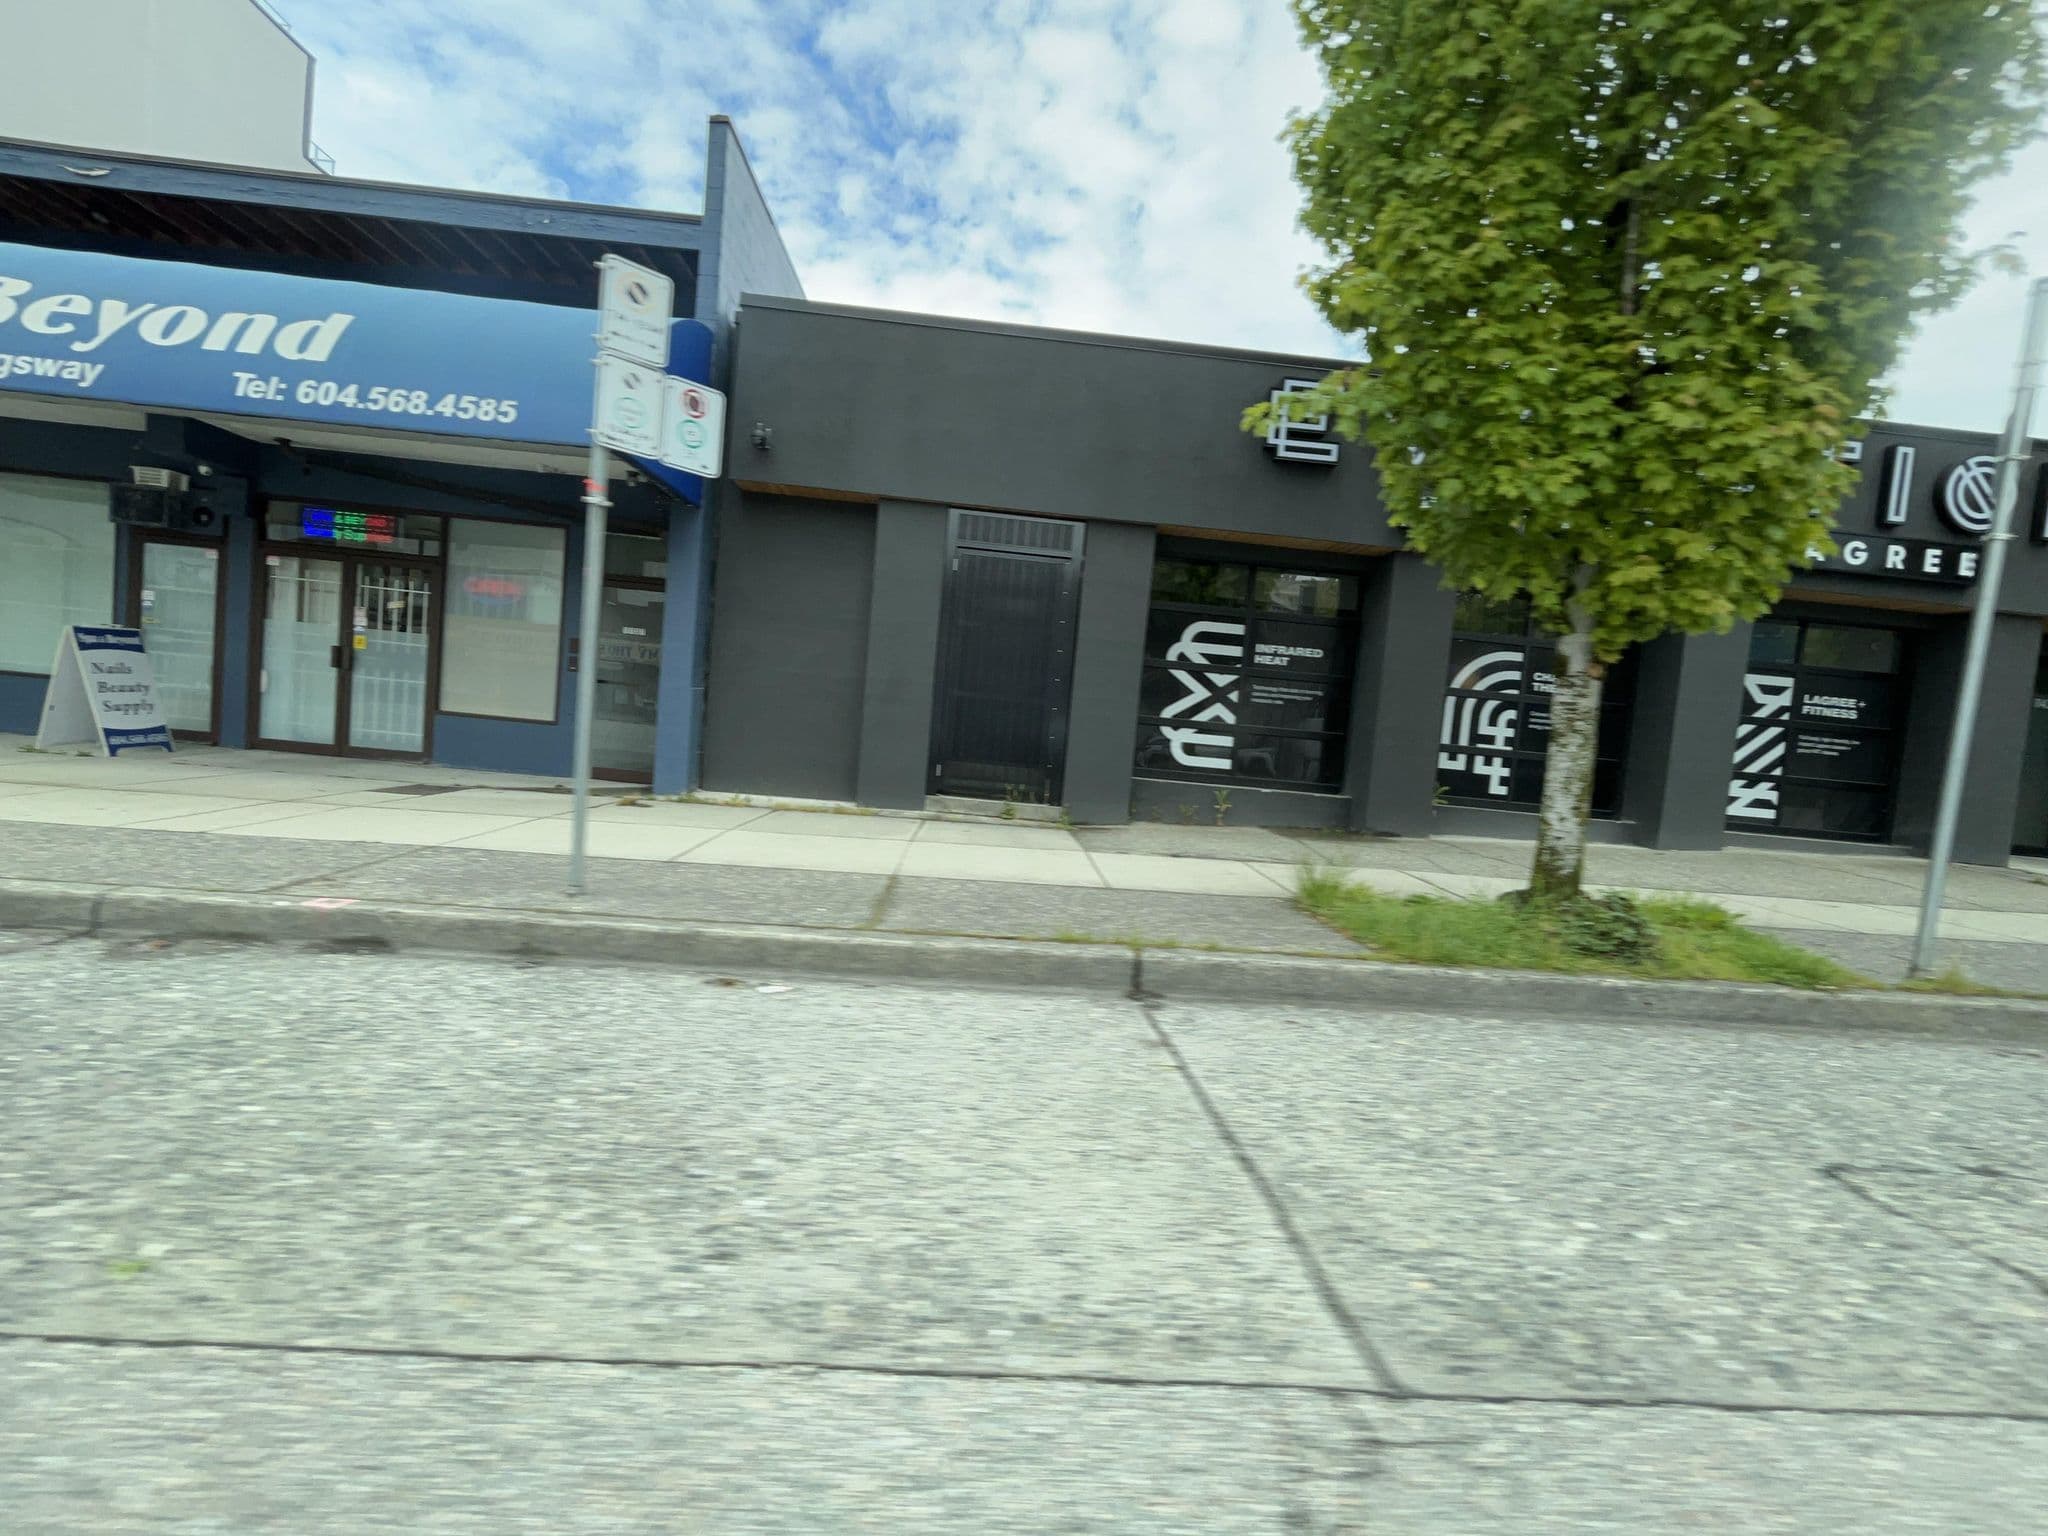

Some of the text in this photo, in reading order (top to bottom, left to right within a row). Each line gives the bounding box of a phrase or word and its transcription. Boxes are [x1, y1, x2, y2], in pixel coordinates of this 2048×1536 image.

[0, 276, 355, 362] Beyond
[232, 371, 518, 425] Tel: 604.568.4585
[1804, 540, 1980, 578] AGREE
[1255, 643, 1325, 659] INFRARED
[1253, 654, 1291, 666] HEAT
[91, 662, 133, 675] Nails
[97, 681, 150, 697] Beauty
[102, 699, 154, 715] Supply
[1800, 705, 1859, 720] FITNESS
